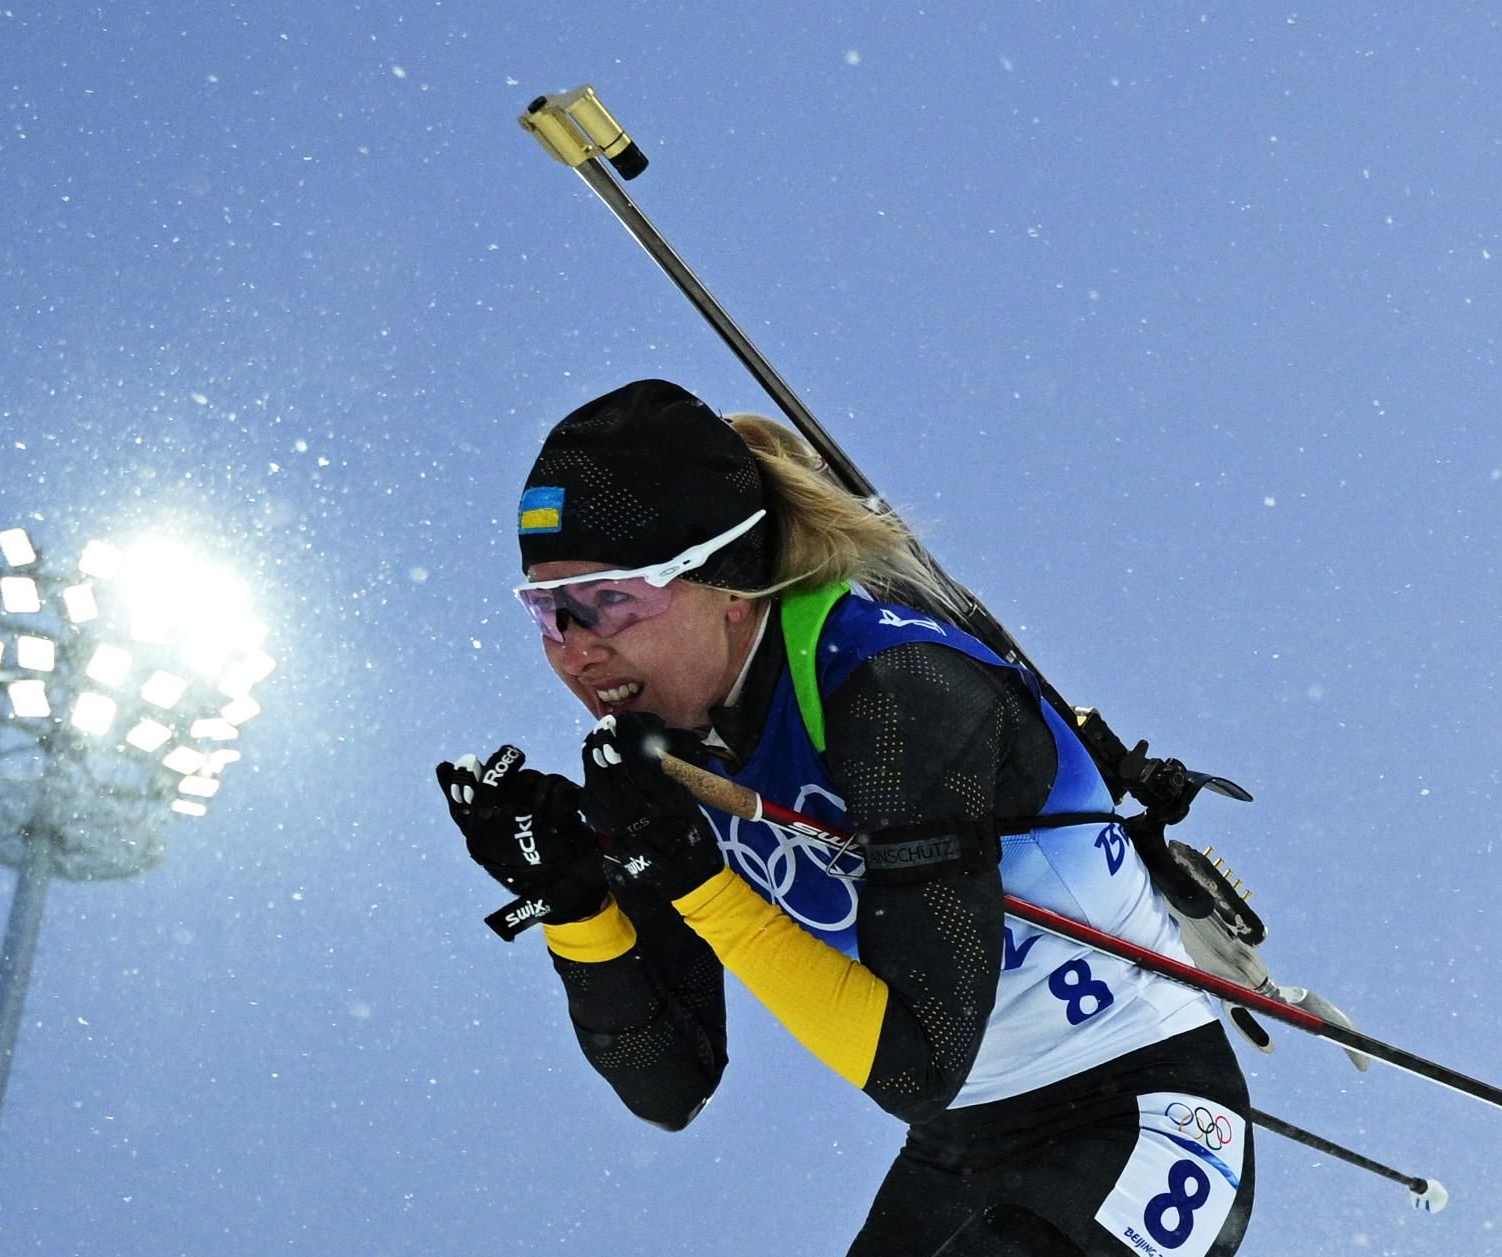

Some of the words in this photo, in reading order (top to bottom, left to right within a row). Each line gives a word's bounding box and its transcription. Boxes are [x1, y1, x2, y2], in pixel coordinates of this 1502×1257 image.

[1048, 957, 1115, 1026] 8
[1143, 1158, 1211, 1250] 8
[1123, 1226, 1157, 1257] BEIJING
